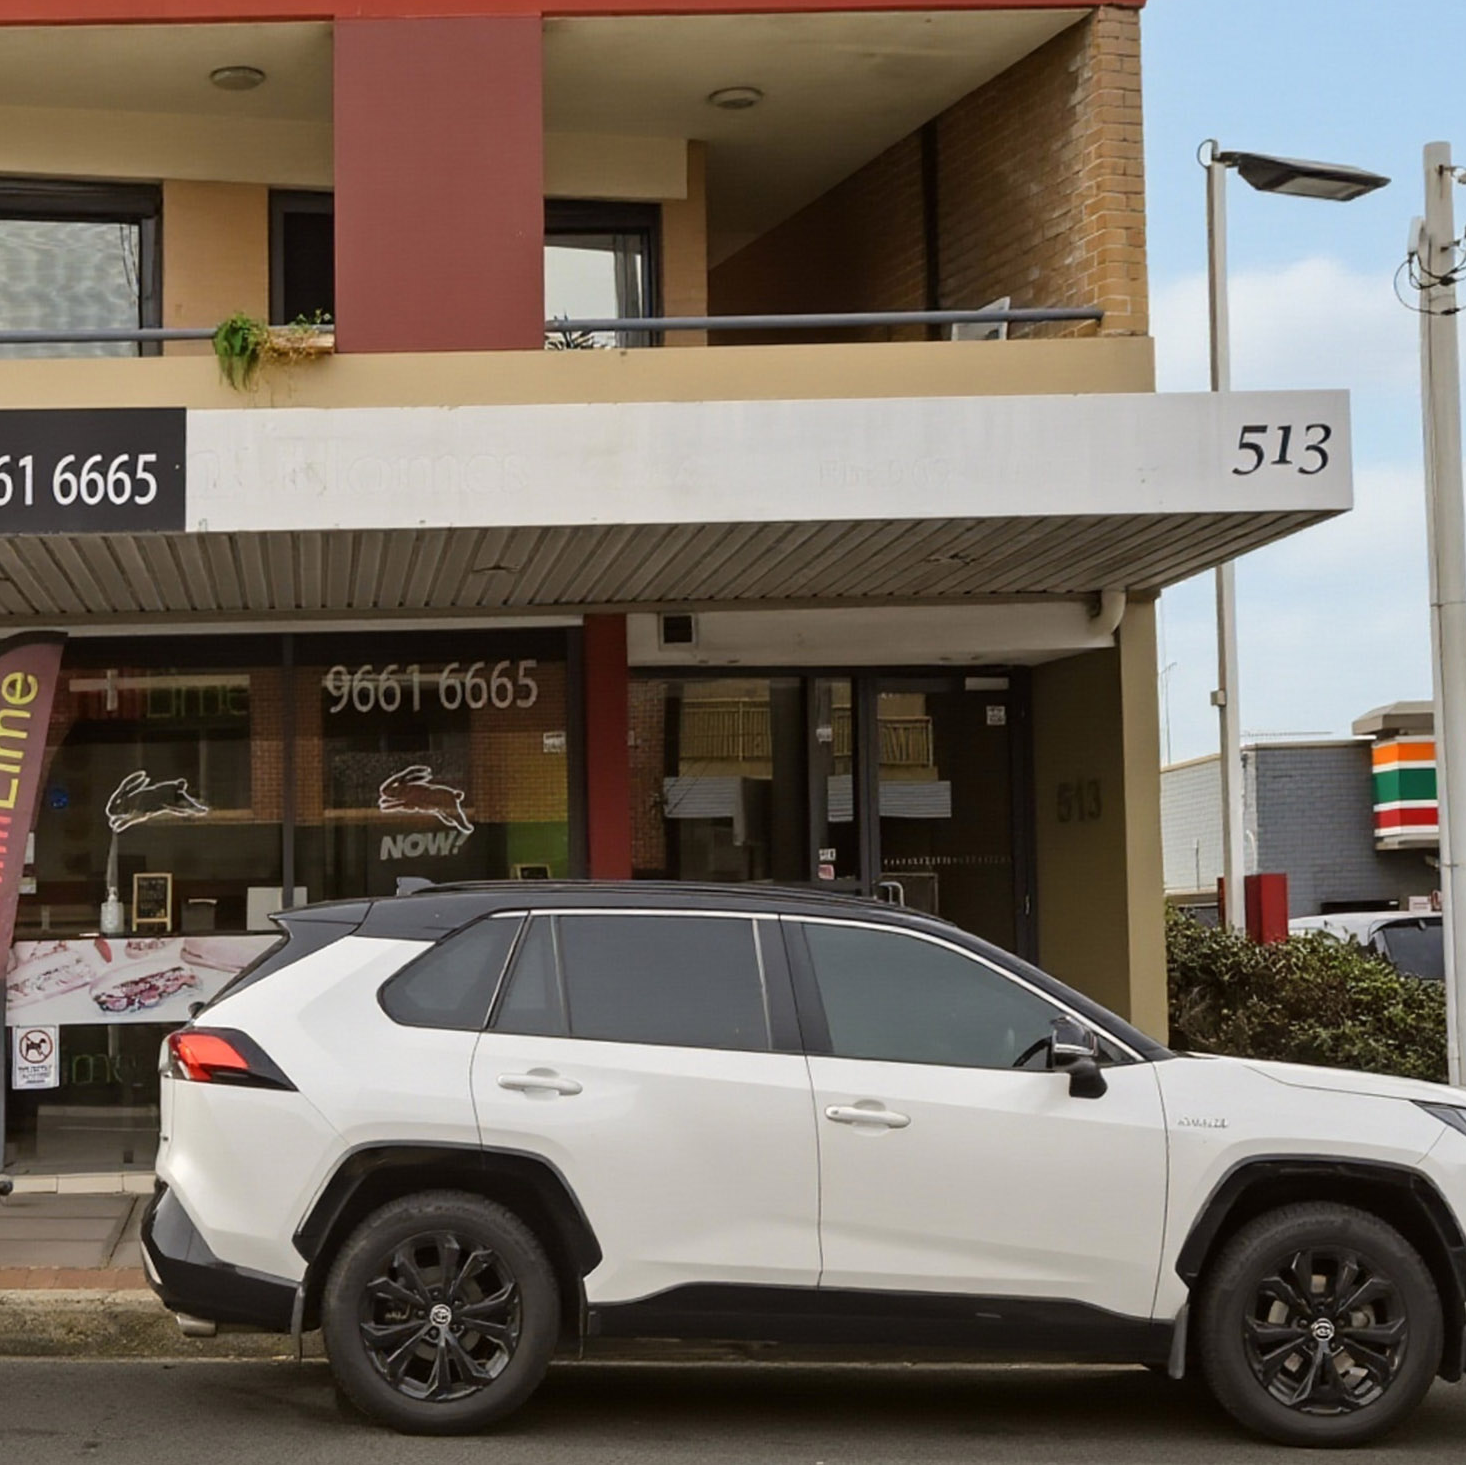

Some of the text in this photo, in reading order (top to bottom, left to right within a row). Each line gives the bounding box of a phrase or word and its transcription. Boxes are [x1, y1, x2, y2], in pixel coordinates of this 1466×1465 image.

[1231, 422, 1333, 475] 513
[51, 452, 159, 506] 6665
[325, 659, 539, 714] 9661 6665
